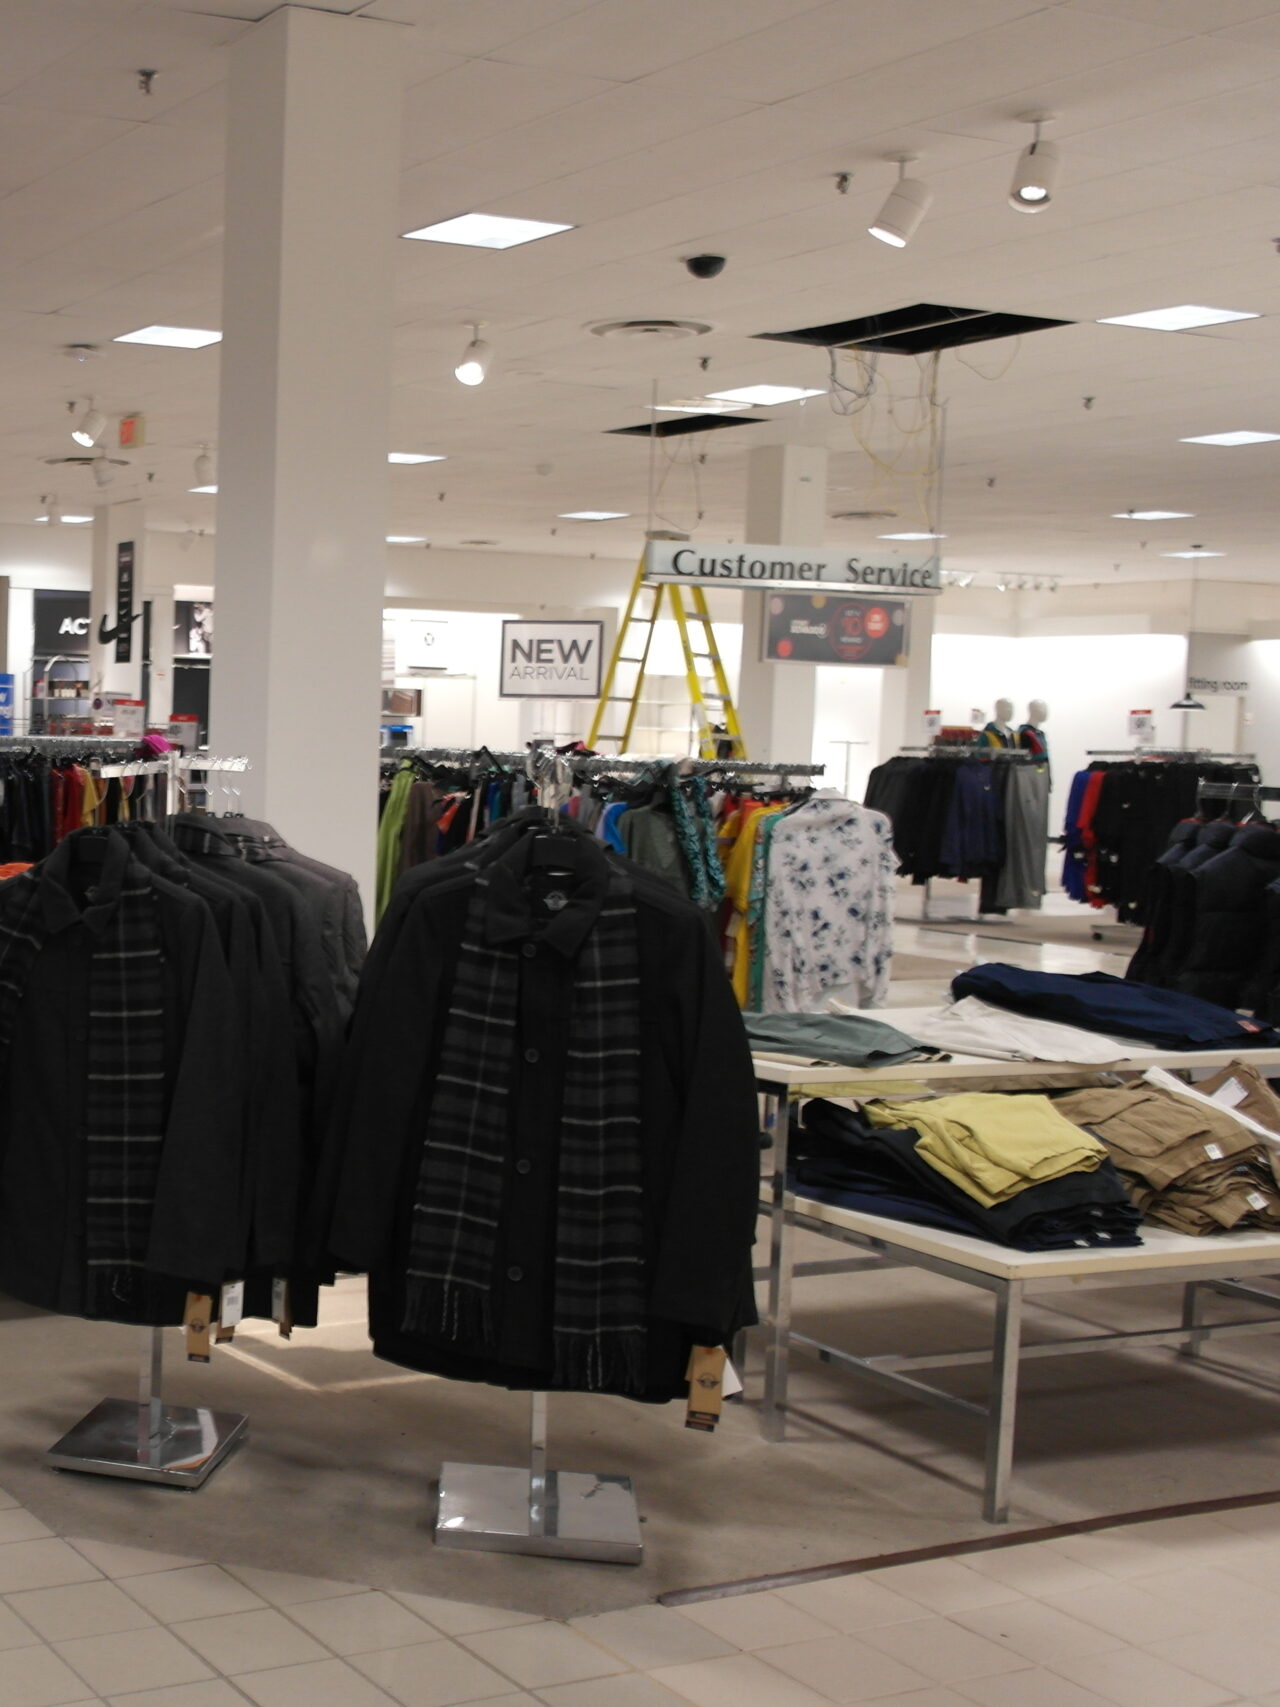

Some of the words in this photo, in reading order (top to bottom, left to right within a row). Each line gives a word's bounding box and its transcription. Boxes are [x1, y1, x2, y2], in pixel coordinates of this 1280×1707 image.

[672, 549, 827, 581] Customer
[845, 558, 933, 588] Service
[510, 639, 593, 664] NEW
[509, 665, 590, 681] ARRIVAL
